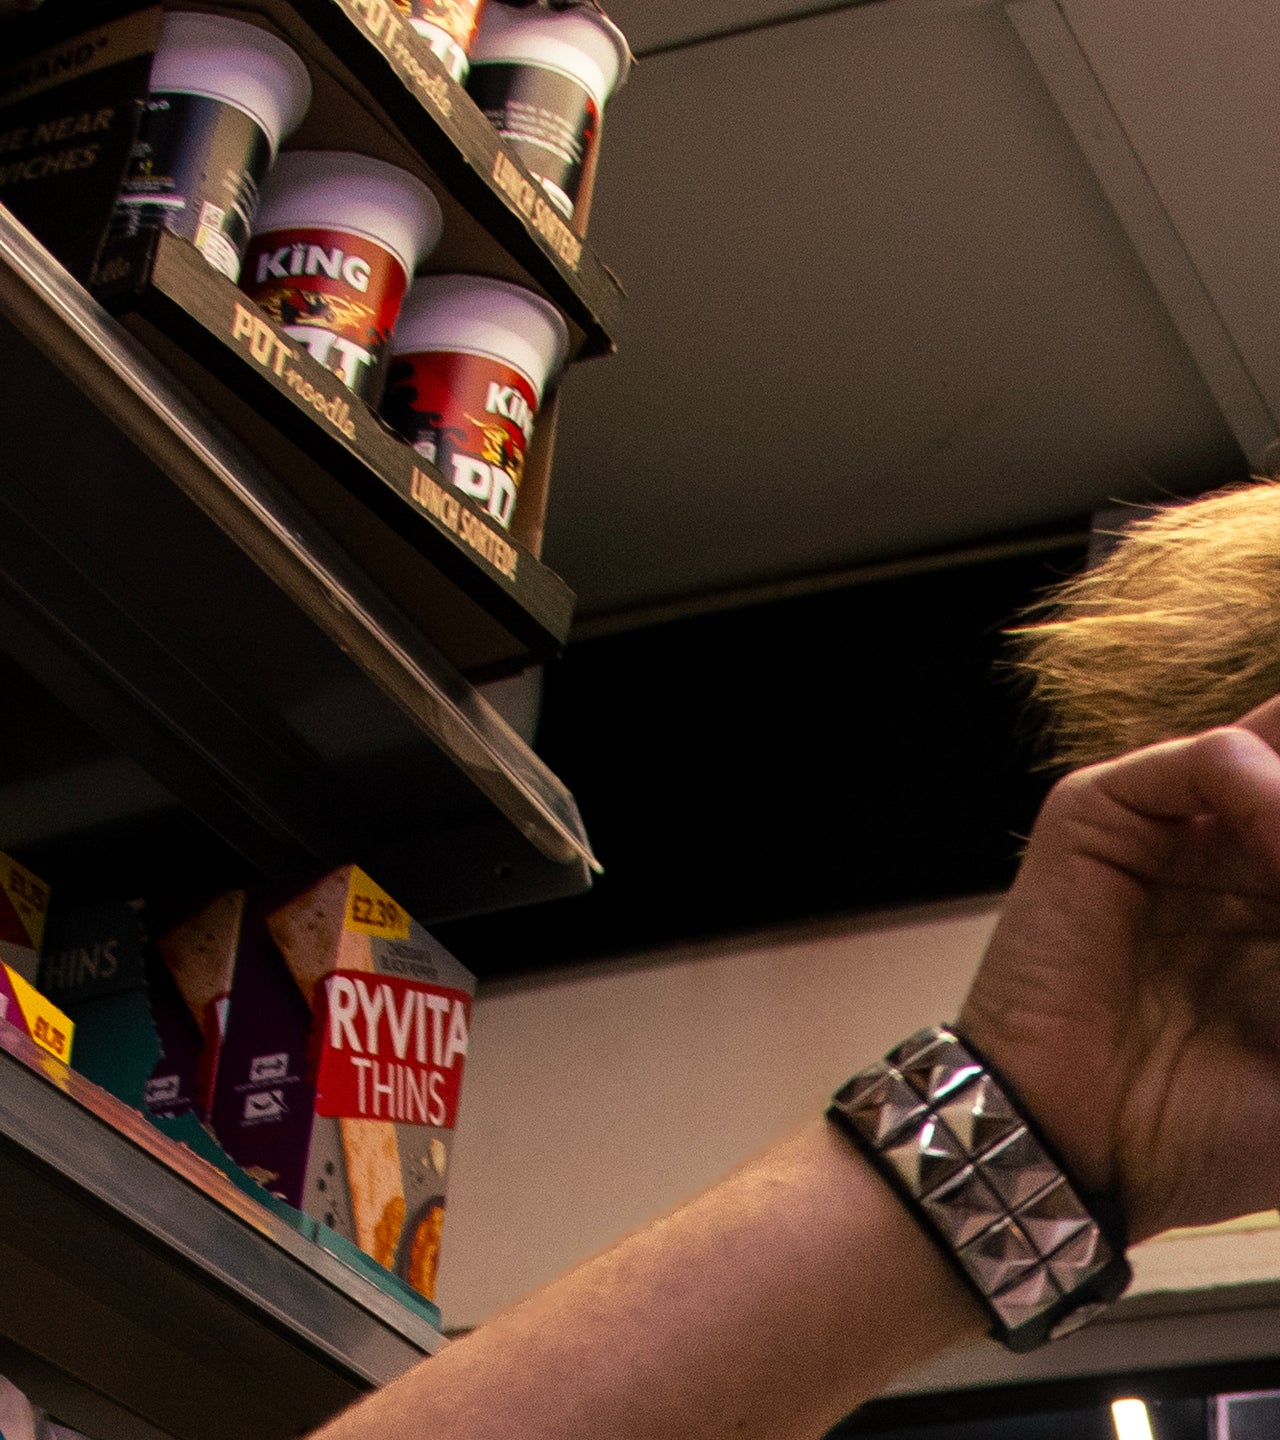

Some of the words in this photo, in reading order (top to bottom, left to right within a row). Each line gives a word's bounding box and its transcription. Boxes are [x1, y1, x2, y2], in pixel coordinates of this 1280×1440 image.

[231, 301, 298, 375] POT
[284, 366, 357, 442] noodle
[410, 464, 462, 532] LUNCH
[325, 975, 470, 1069] RYVITA
[349, 1056, 448, 1129] THINS
